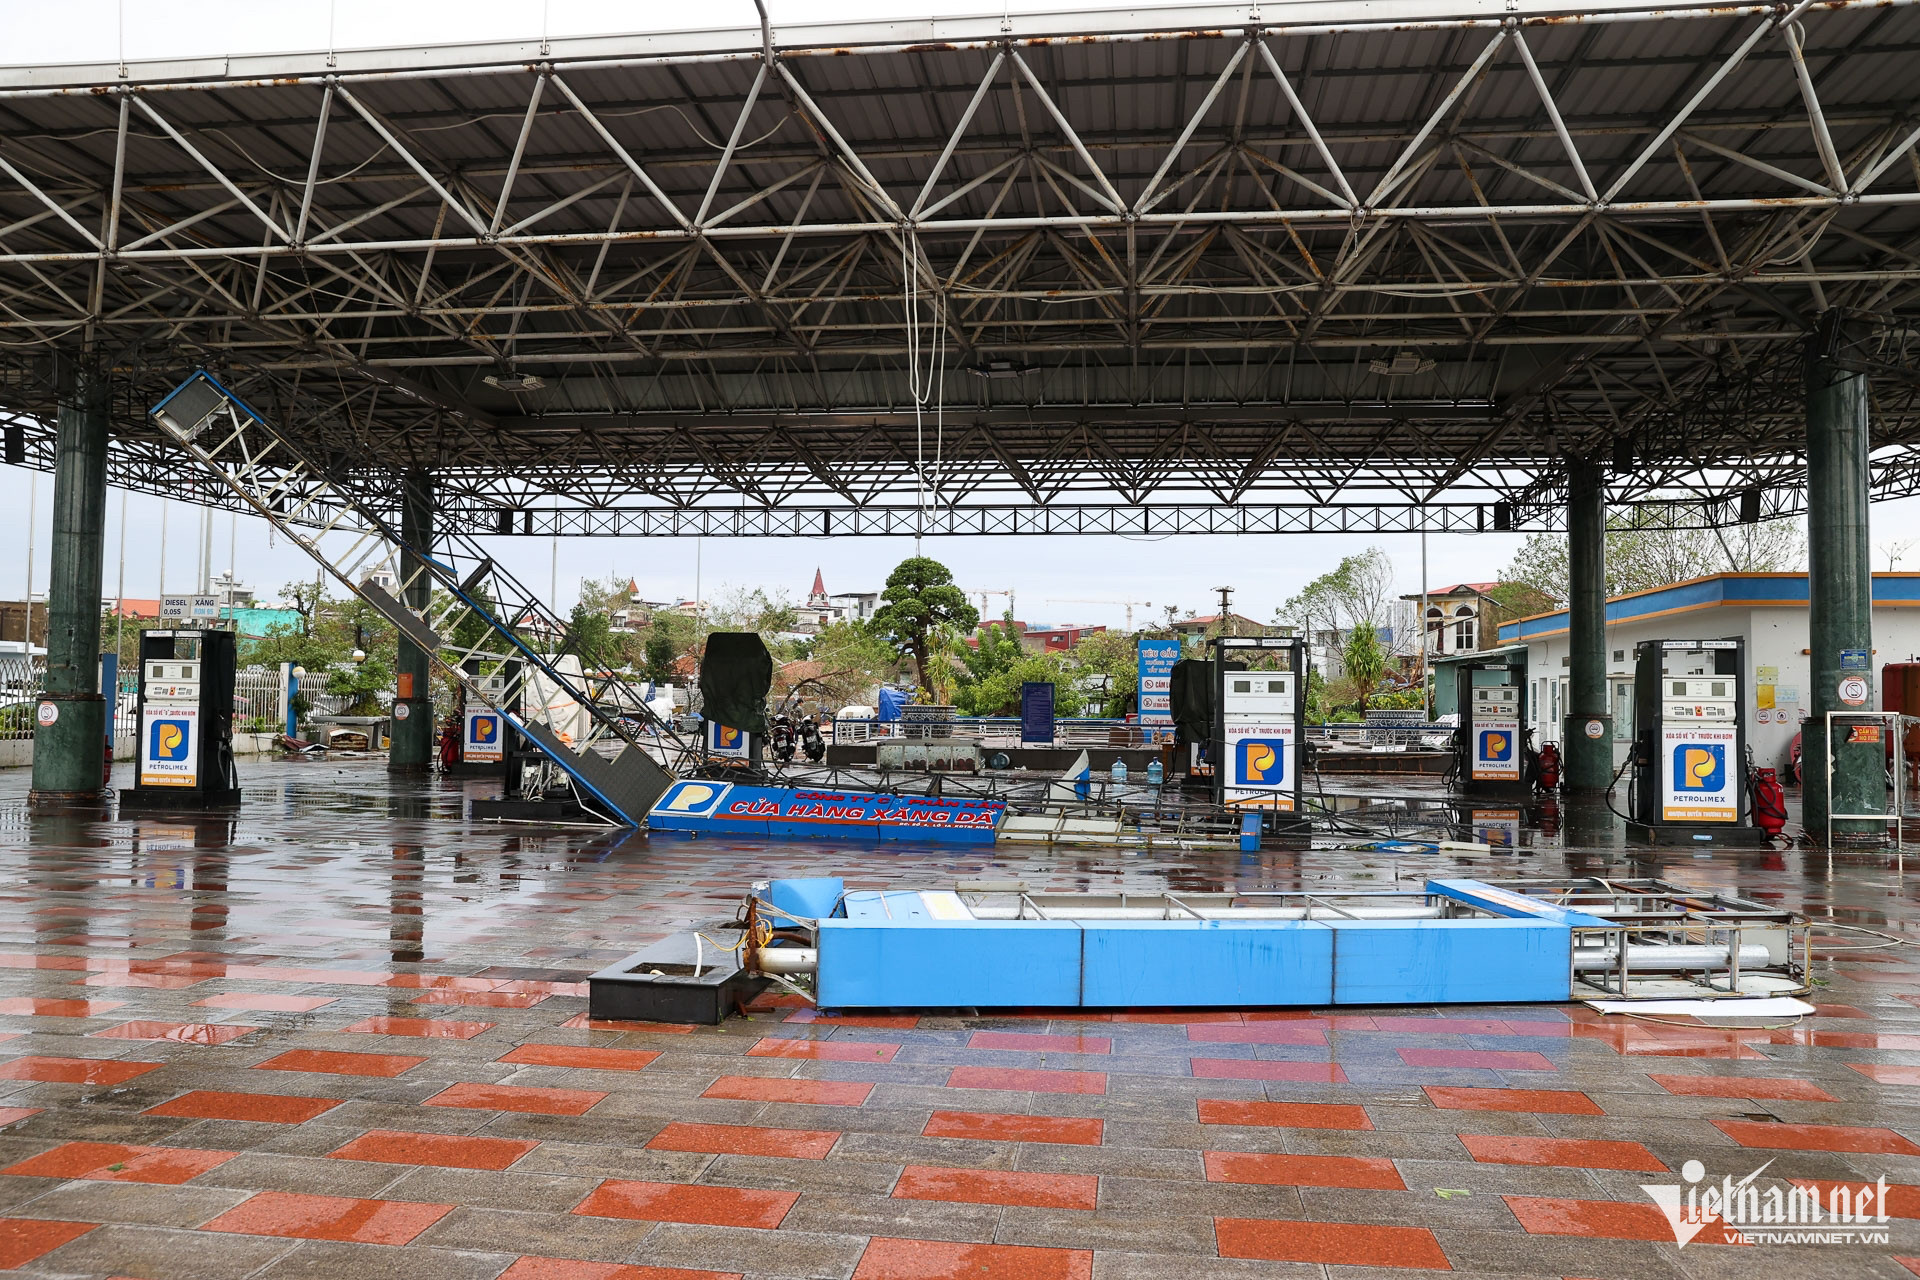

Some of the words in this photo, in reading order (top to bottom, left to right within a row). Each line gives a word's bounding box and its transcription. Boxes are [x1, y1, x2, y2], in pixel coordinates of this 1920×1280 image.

[163, 608, 181, 616] 0,05S
[1155, 680, 1165, 688] CẤM
[795, 791, 846, 802] CÔNG
[850, 795, 876, 803] TY
[907, 797, 959, 808] PHẦN
[729, 797, 781, 816] CỬA
[787, 802, 866, 820] HÀNG
[867, 807, 951, 823] XĂNG
[954, 809, 998, 824] DẦ
